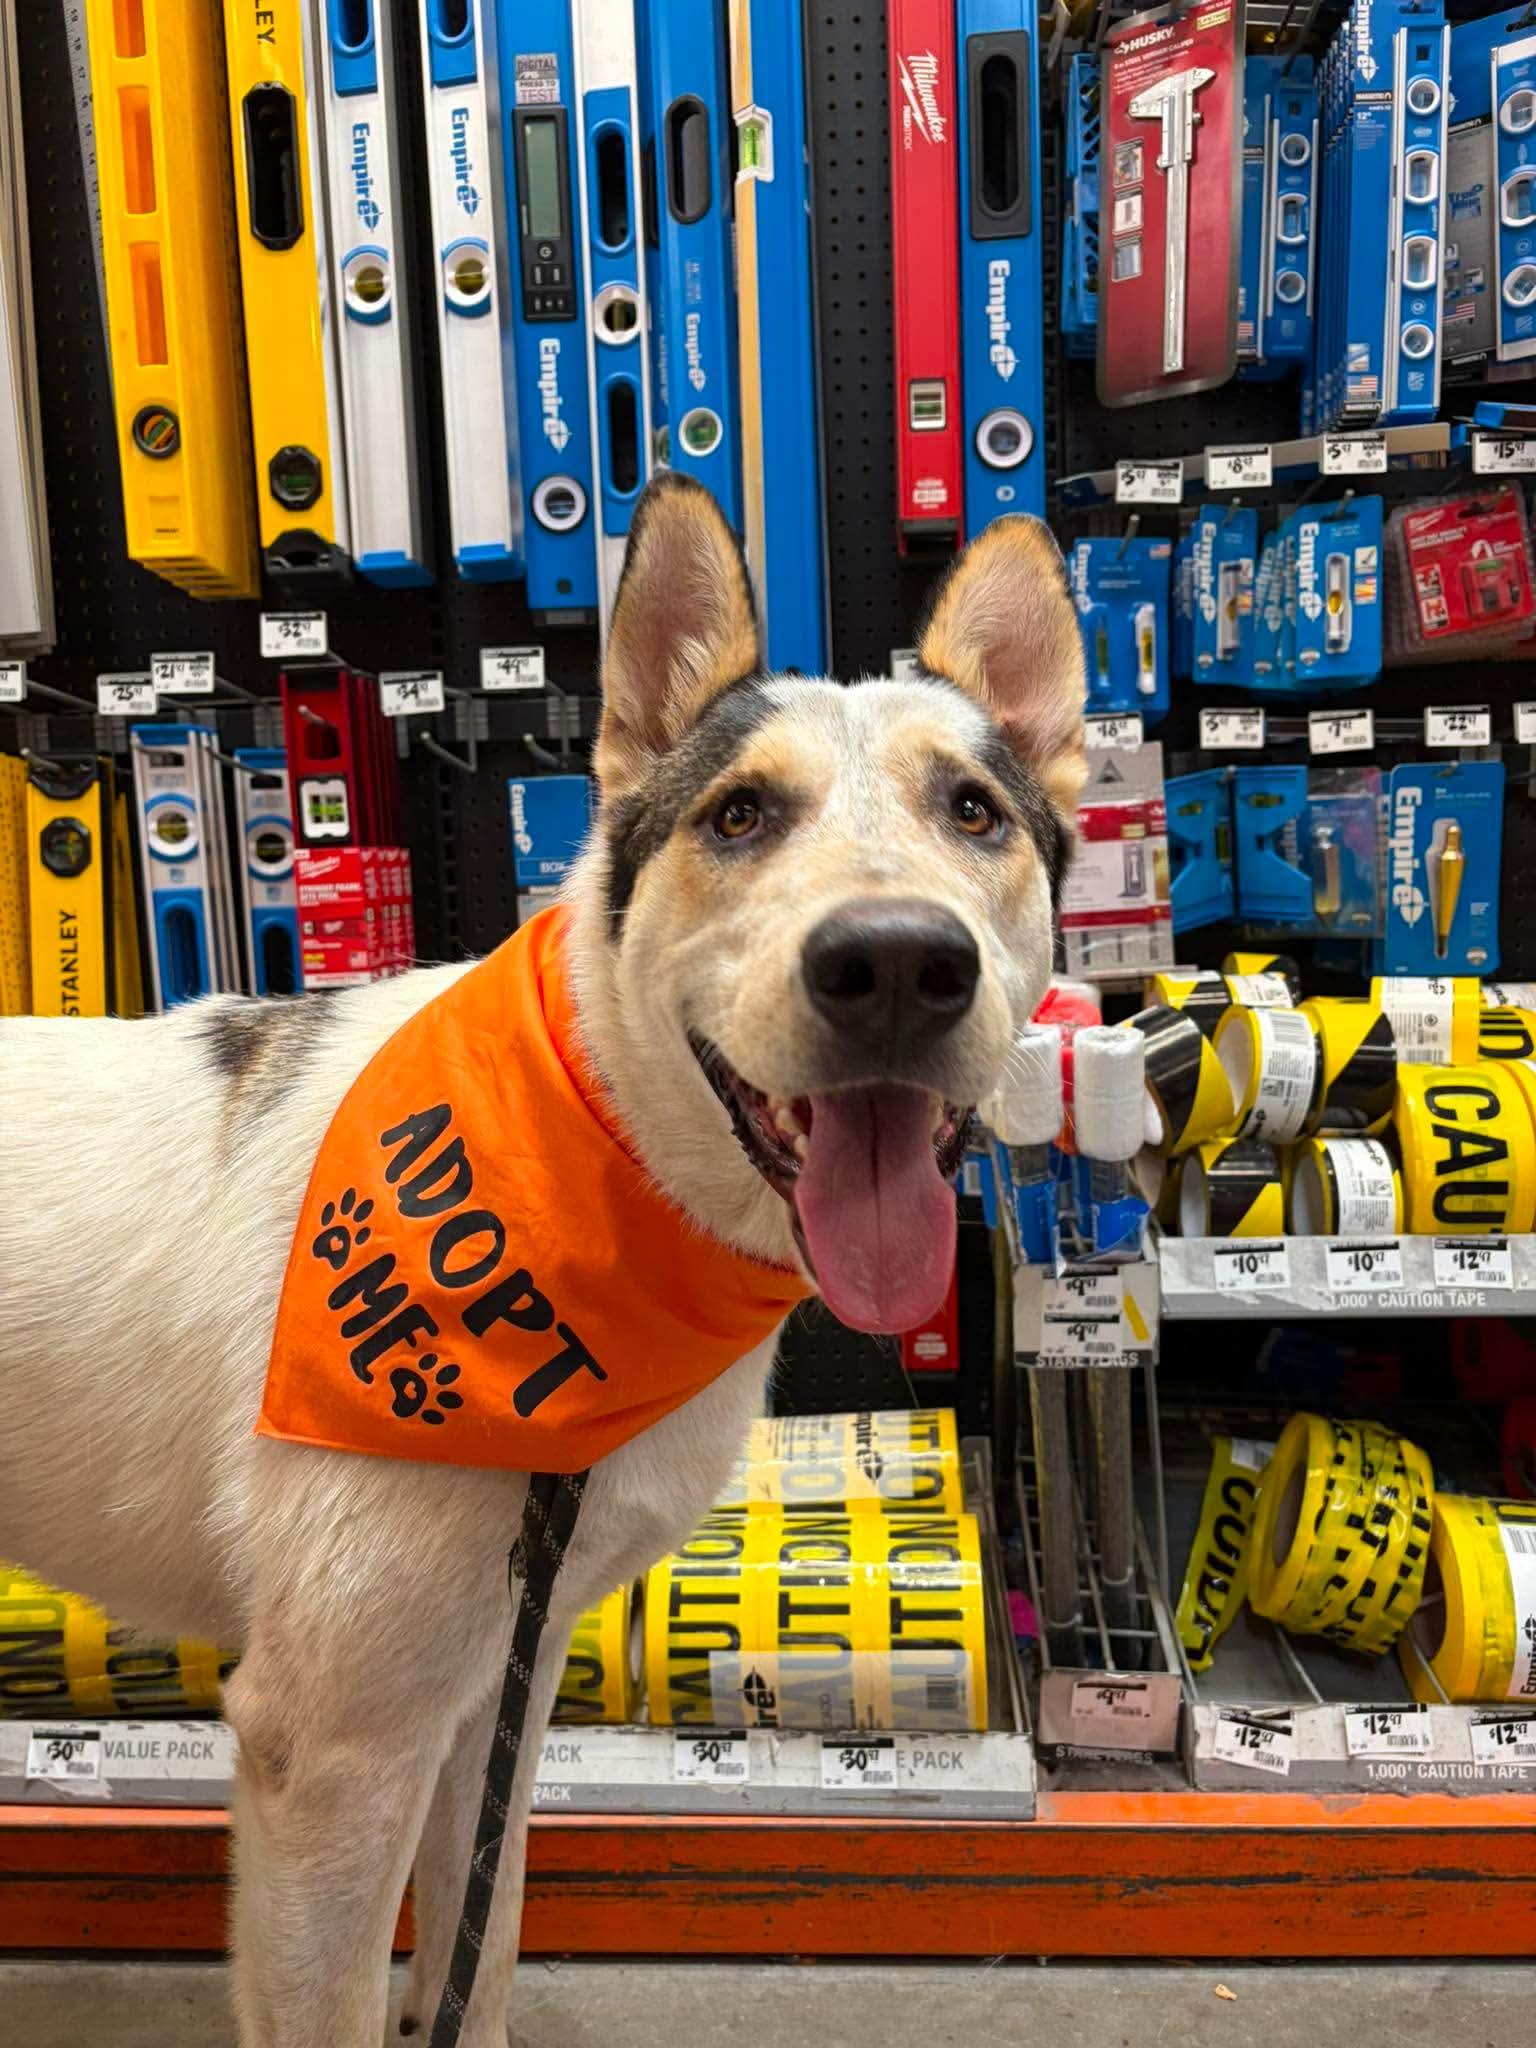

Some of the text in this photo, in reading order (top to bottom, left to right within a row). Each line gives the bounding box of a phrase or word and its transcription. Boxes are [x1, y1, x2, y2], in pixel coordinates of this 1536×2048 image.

[517, 58, 556, 70] DIGITAL
[1130, 26, 1173, 52] HUSKY
[519, 88, 555, 103] TEST
[907, 48, 948, 143] Milwaukee
[352, 122, 380, 226] Empire
[450, 107, 478, 213] Empire
[685, 313, 706, 392] Empire
[986, 259, 1016, 380] Empire
[538, 338, 568, 446] Empire
[1298, 522, 1324, 621] Empire
[1388, 786, 1426, 926] Empire
[62, 910, 80, 1017] STANLEY
[1425, 1085, 1510, 1234] CAU
[380, 1103, 608, 1418] ADOPT
[1378, 1292, 1443, 1308] CAUTION
[1449, 1291, 1486, 1307] TAPE
[328, 1253, 439, 1384] ME
[104, 1740, 214, 1761] VALUE PACK
[543, 1743, 583, 1763] ACK
[912, 1749, 965, 1770] PACK
[1367, 1762, 1529, 1780] 1,000' CAUTION TAPE
